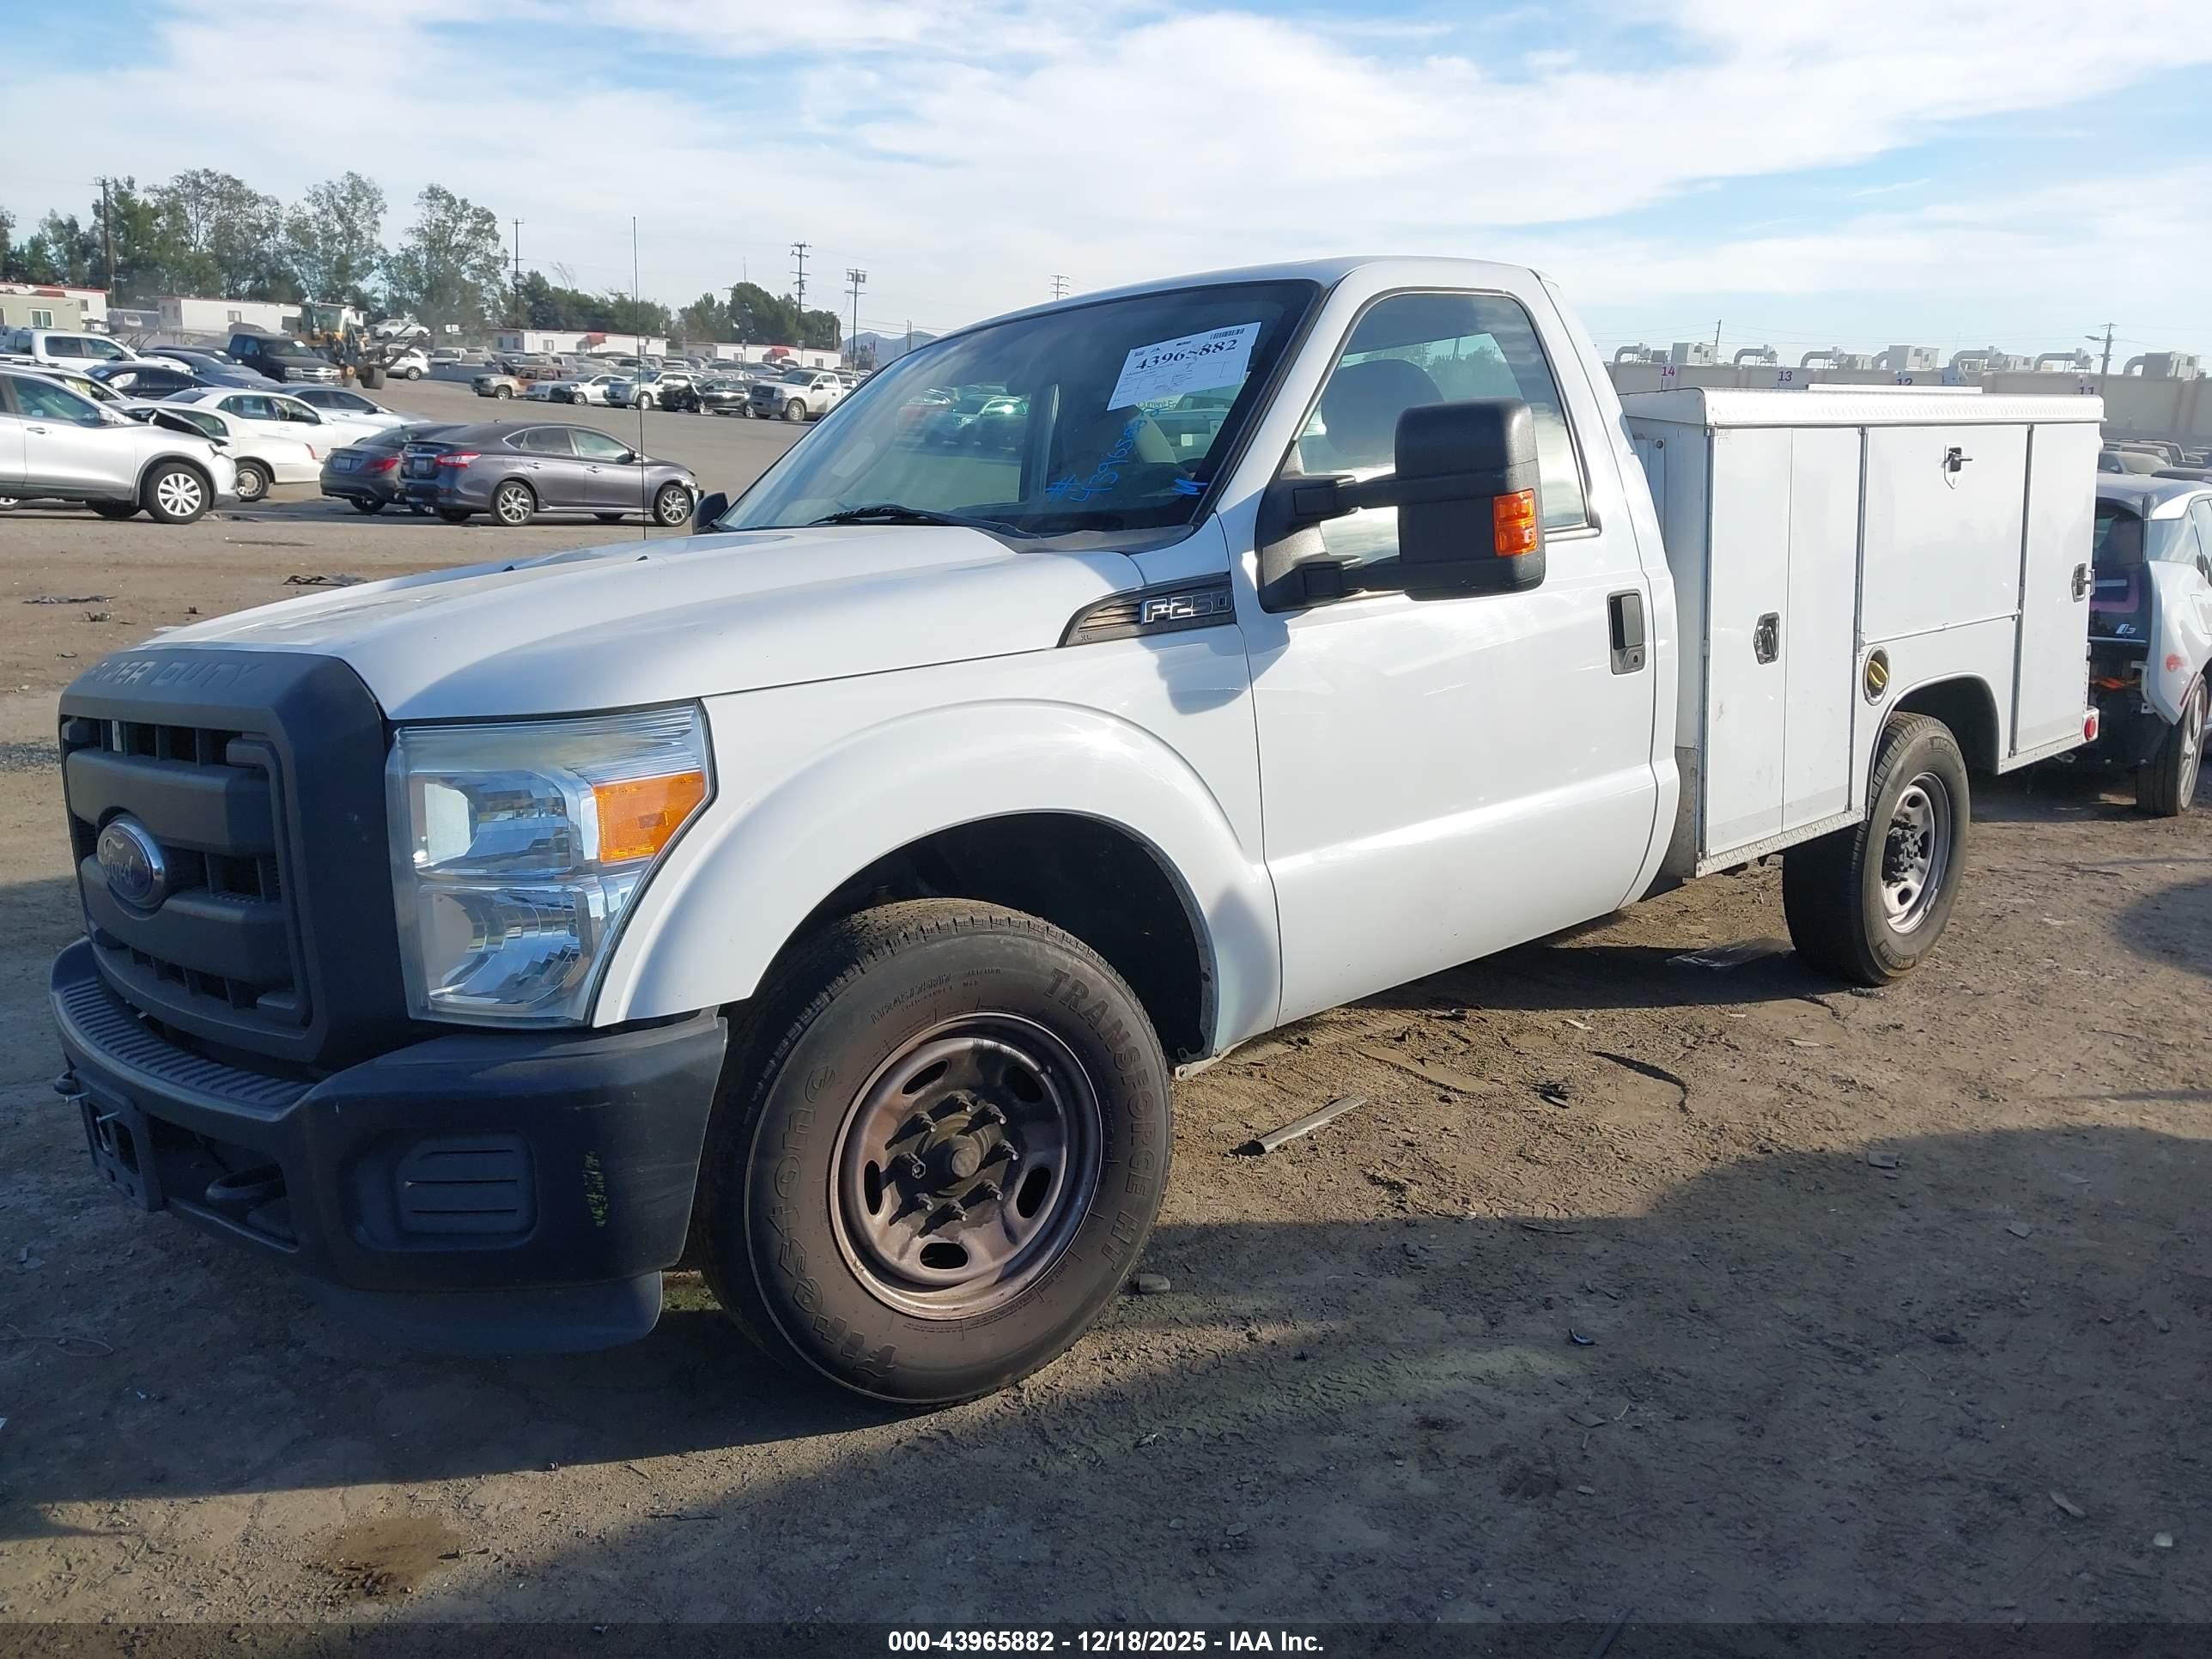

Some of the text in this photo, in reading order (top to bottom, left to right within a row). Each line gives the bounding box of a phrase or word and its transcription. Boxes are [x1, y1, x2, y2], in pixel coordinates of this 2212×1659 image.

[1662, 366, 1675, 376] 14
[1778, 371, 1793, 381] 13
[1141, 591, 1233, 624] F-250
[1079, 633, 1093, 641] XL
[149, 661, 263, 688] DUTY
[1043, 968, 1157, 1197] TRANSFORCE
[1102, 1210, 1140, 1272] HT
[769, 1065, 898, 1378] Firestone
